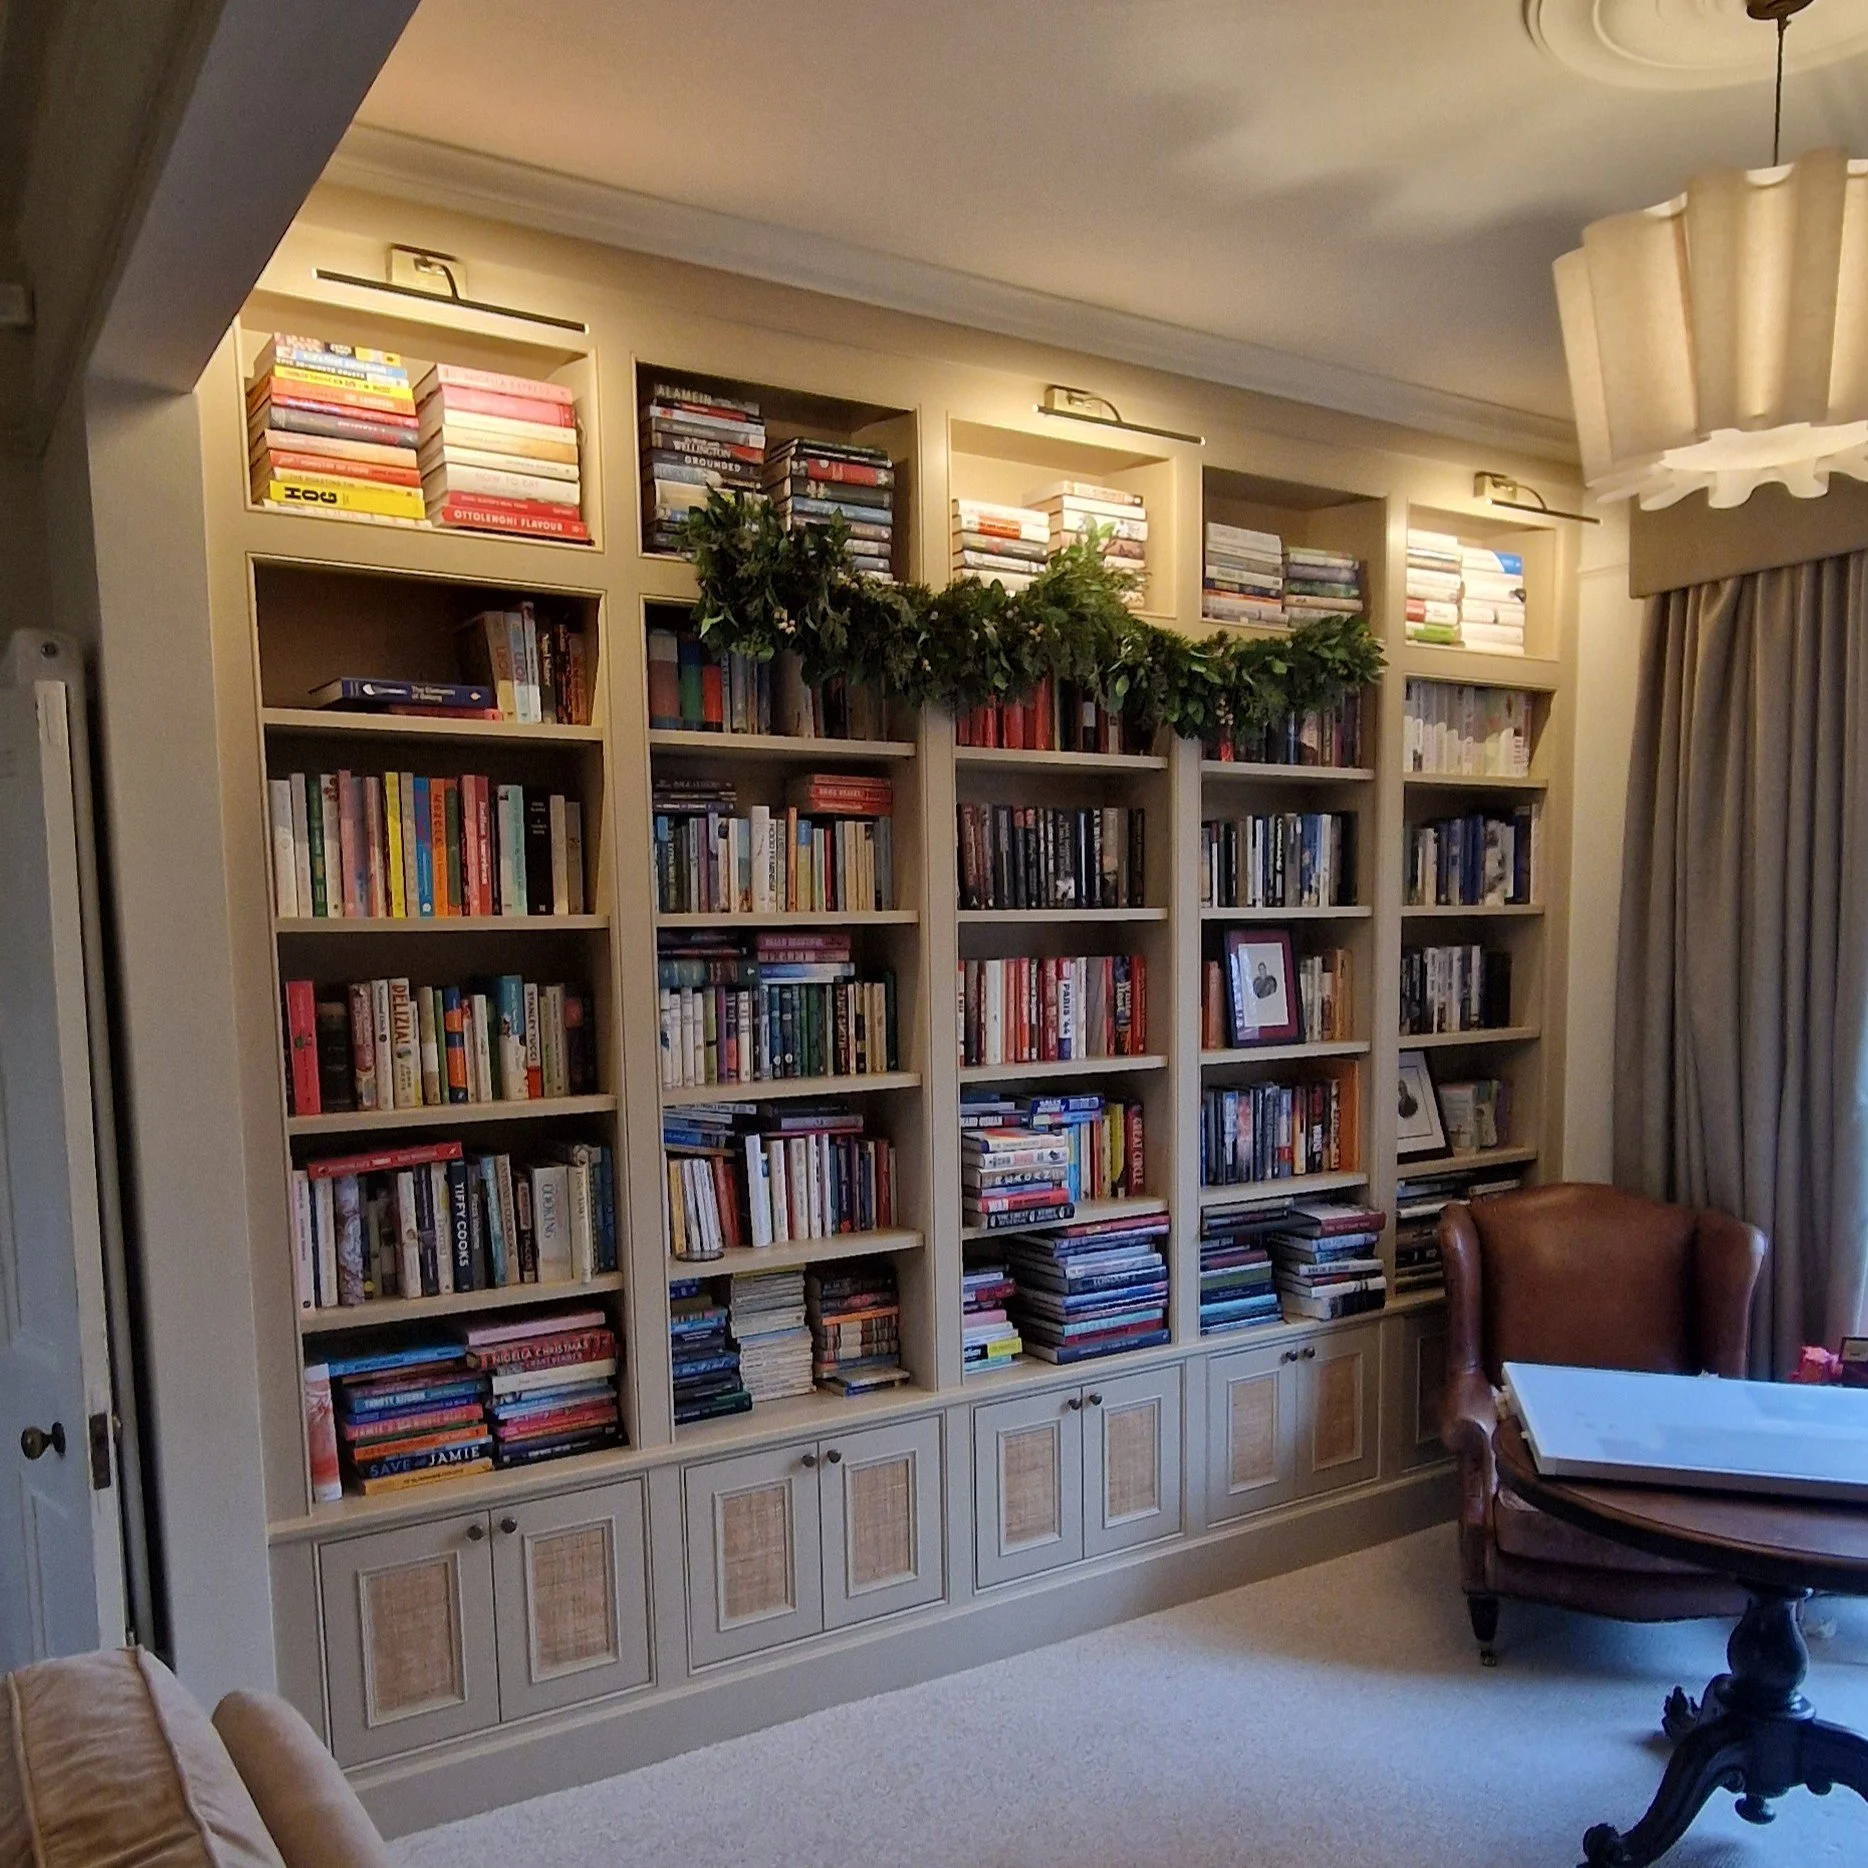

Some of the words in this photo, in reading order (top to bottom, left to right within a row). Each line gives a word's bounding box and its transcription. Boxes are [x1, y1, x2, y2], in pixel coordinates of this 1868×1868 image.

[284, 486, 337, 504] HOG
[454, 509, 517, 526] OTTOLENGHI
[521, 518, 563, 532] FLAVOUR
[392, 985, 411, 1045] DELIZIA!
[528, 992, 536, 1030] STANLEY
[529, 1034, 537, 1062] TUCCI
[1132, 1117, 1142, 1148] GREAT
[1133, 1151, 1143, 1184] CIRCLE
[454, 1182, 466, 1218] TIFFY
[542, 1183, 556, 1239] COOKING
[457, 1221, 468, 1267] COOKS
[524, 1232, 533, 1270] TACOS
[536, 1339, 588, 1356] CHRISTMAS
[369, 1459, 412, 1477] SAVE
[430, 1446, 479, 1466] JAMIE
